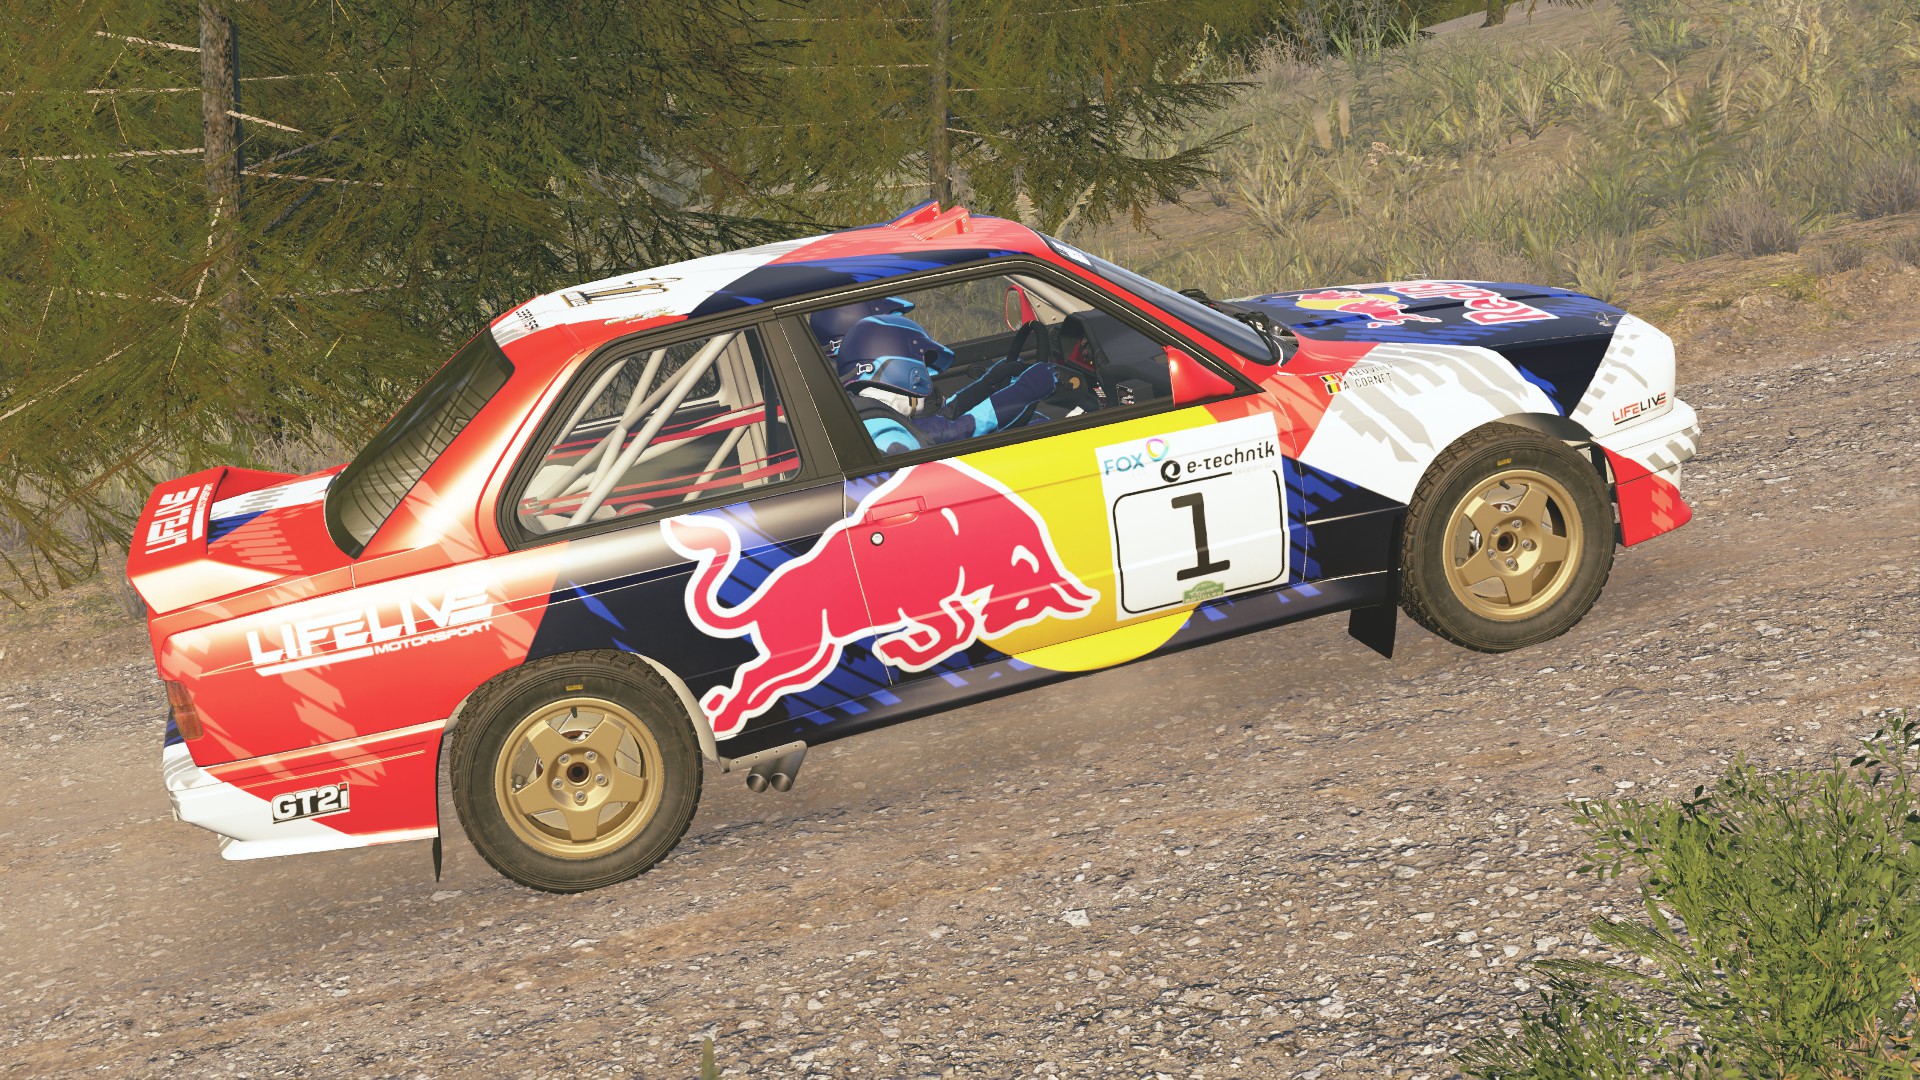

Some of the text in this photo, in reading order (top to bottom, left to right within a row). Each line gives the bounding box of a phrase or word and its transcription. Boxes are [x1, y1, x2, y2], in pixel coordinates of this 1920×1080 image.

[1355, 372, 1393, 388] CORNET
[1612, 392, 1667, 422] LIFELIVE
[1104, 453, 1145, 475] FOX
[1187, 441, 1275, 473] e-technik
[145, 486, 200, 554] LIFELIVE
[1171, 492, 1230, 581] 1
[246, 582, 493, 666] LIFELIVE
[375, 621, 494, 655] MOTORSPORT
[272, 783, 349, 821] GT2i
